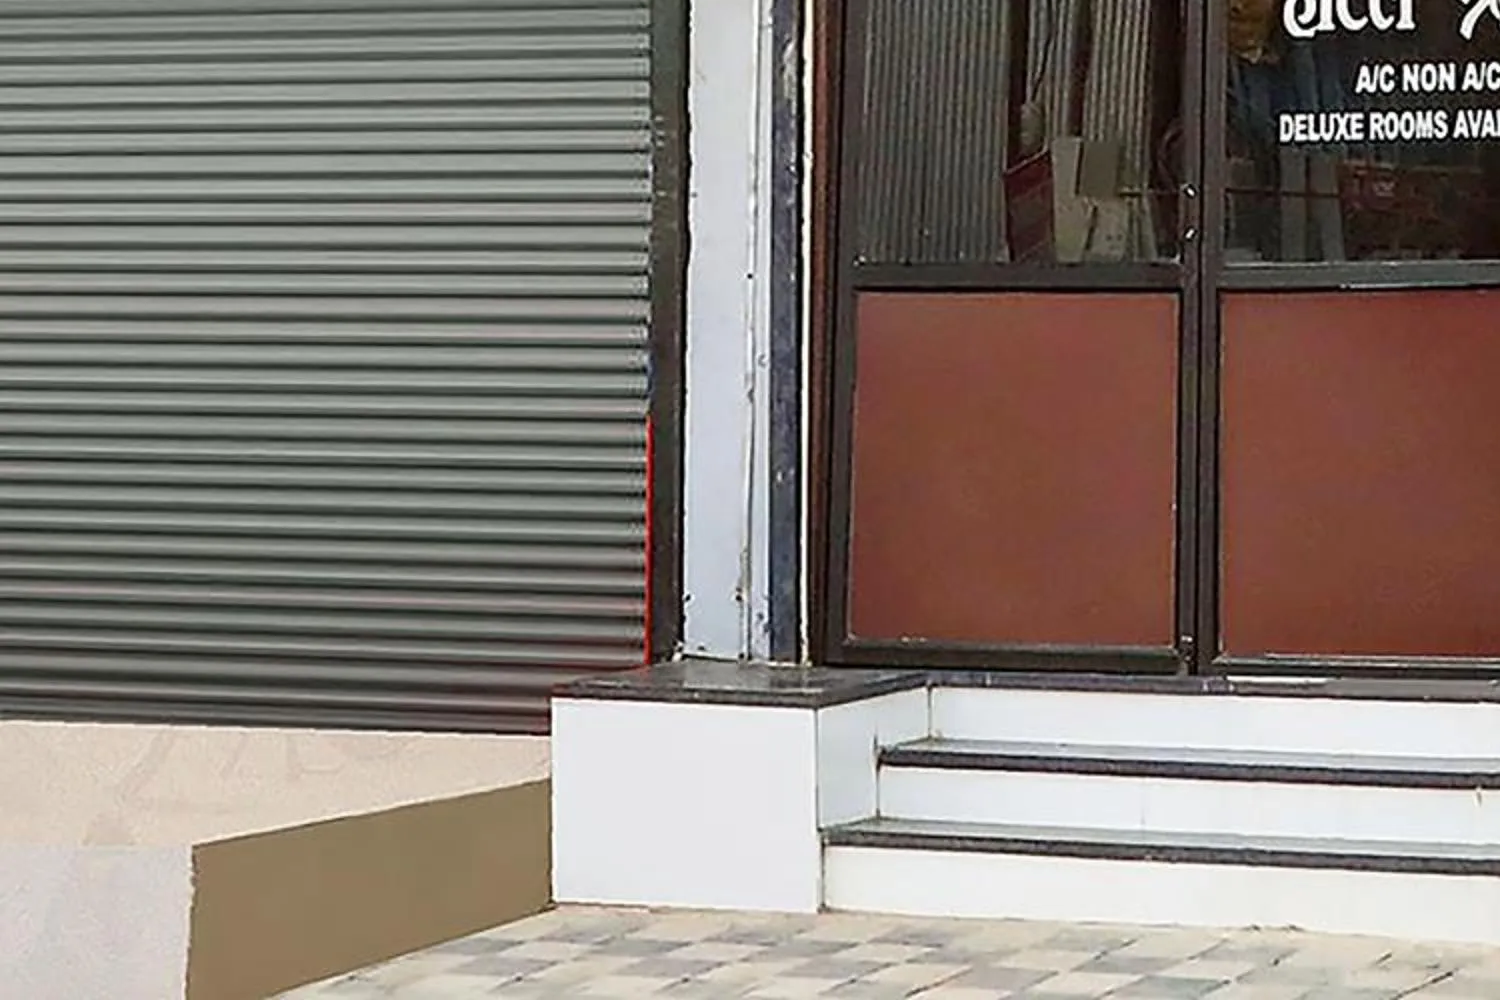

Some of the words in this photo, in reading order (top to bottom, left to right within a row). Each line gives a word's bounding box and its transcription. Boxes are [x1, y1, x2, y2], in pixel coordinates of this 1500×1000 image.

[1354, 64, 1396, 94] A/C
[1402, 63, 1456, 92] NON
[1279, 112, 1365, 143] DELUXE
[1368, 110, 1449, 141] ROOMS
